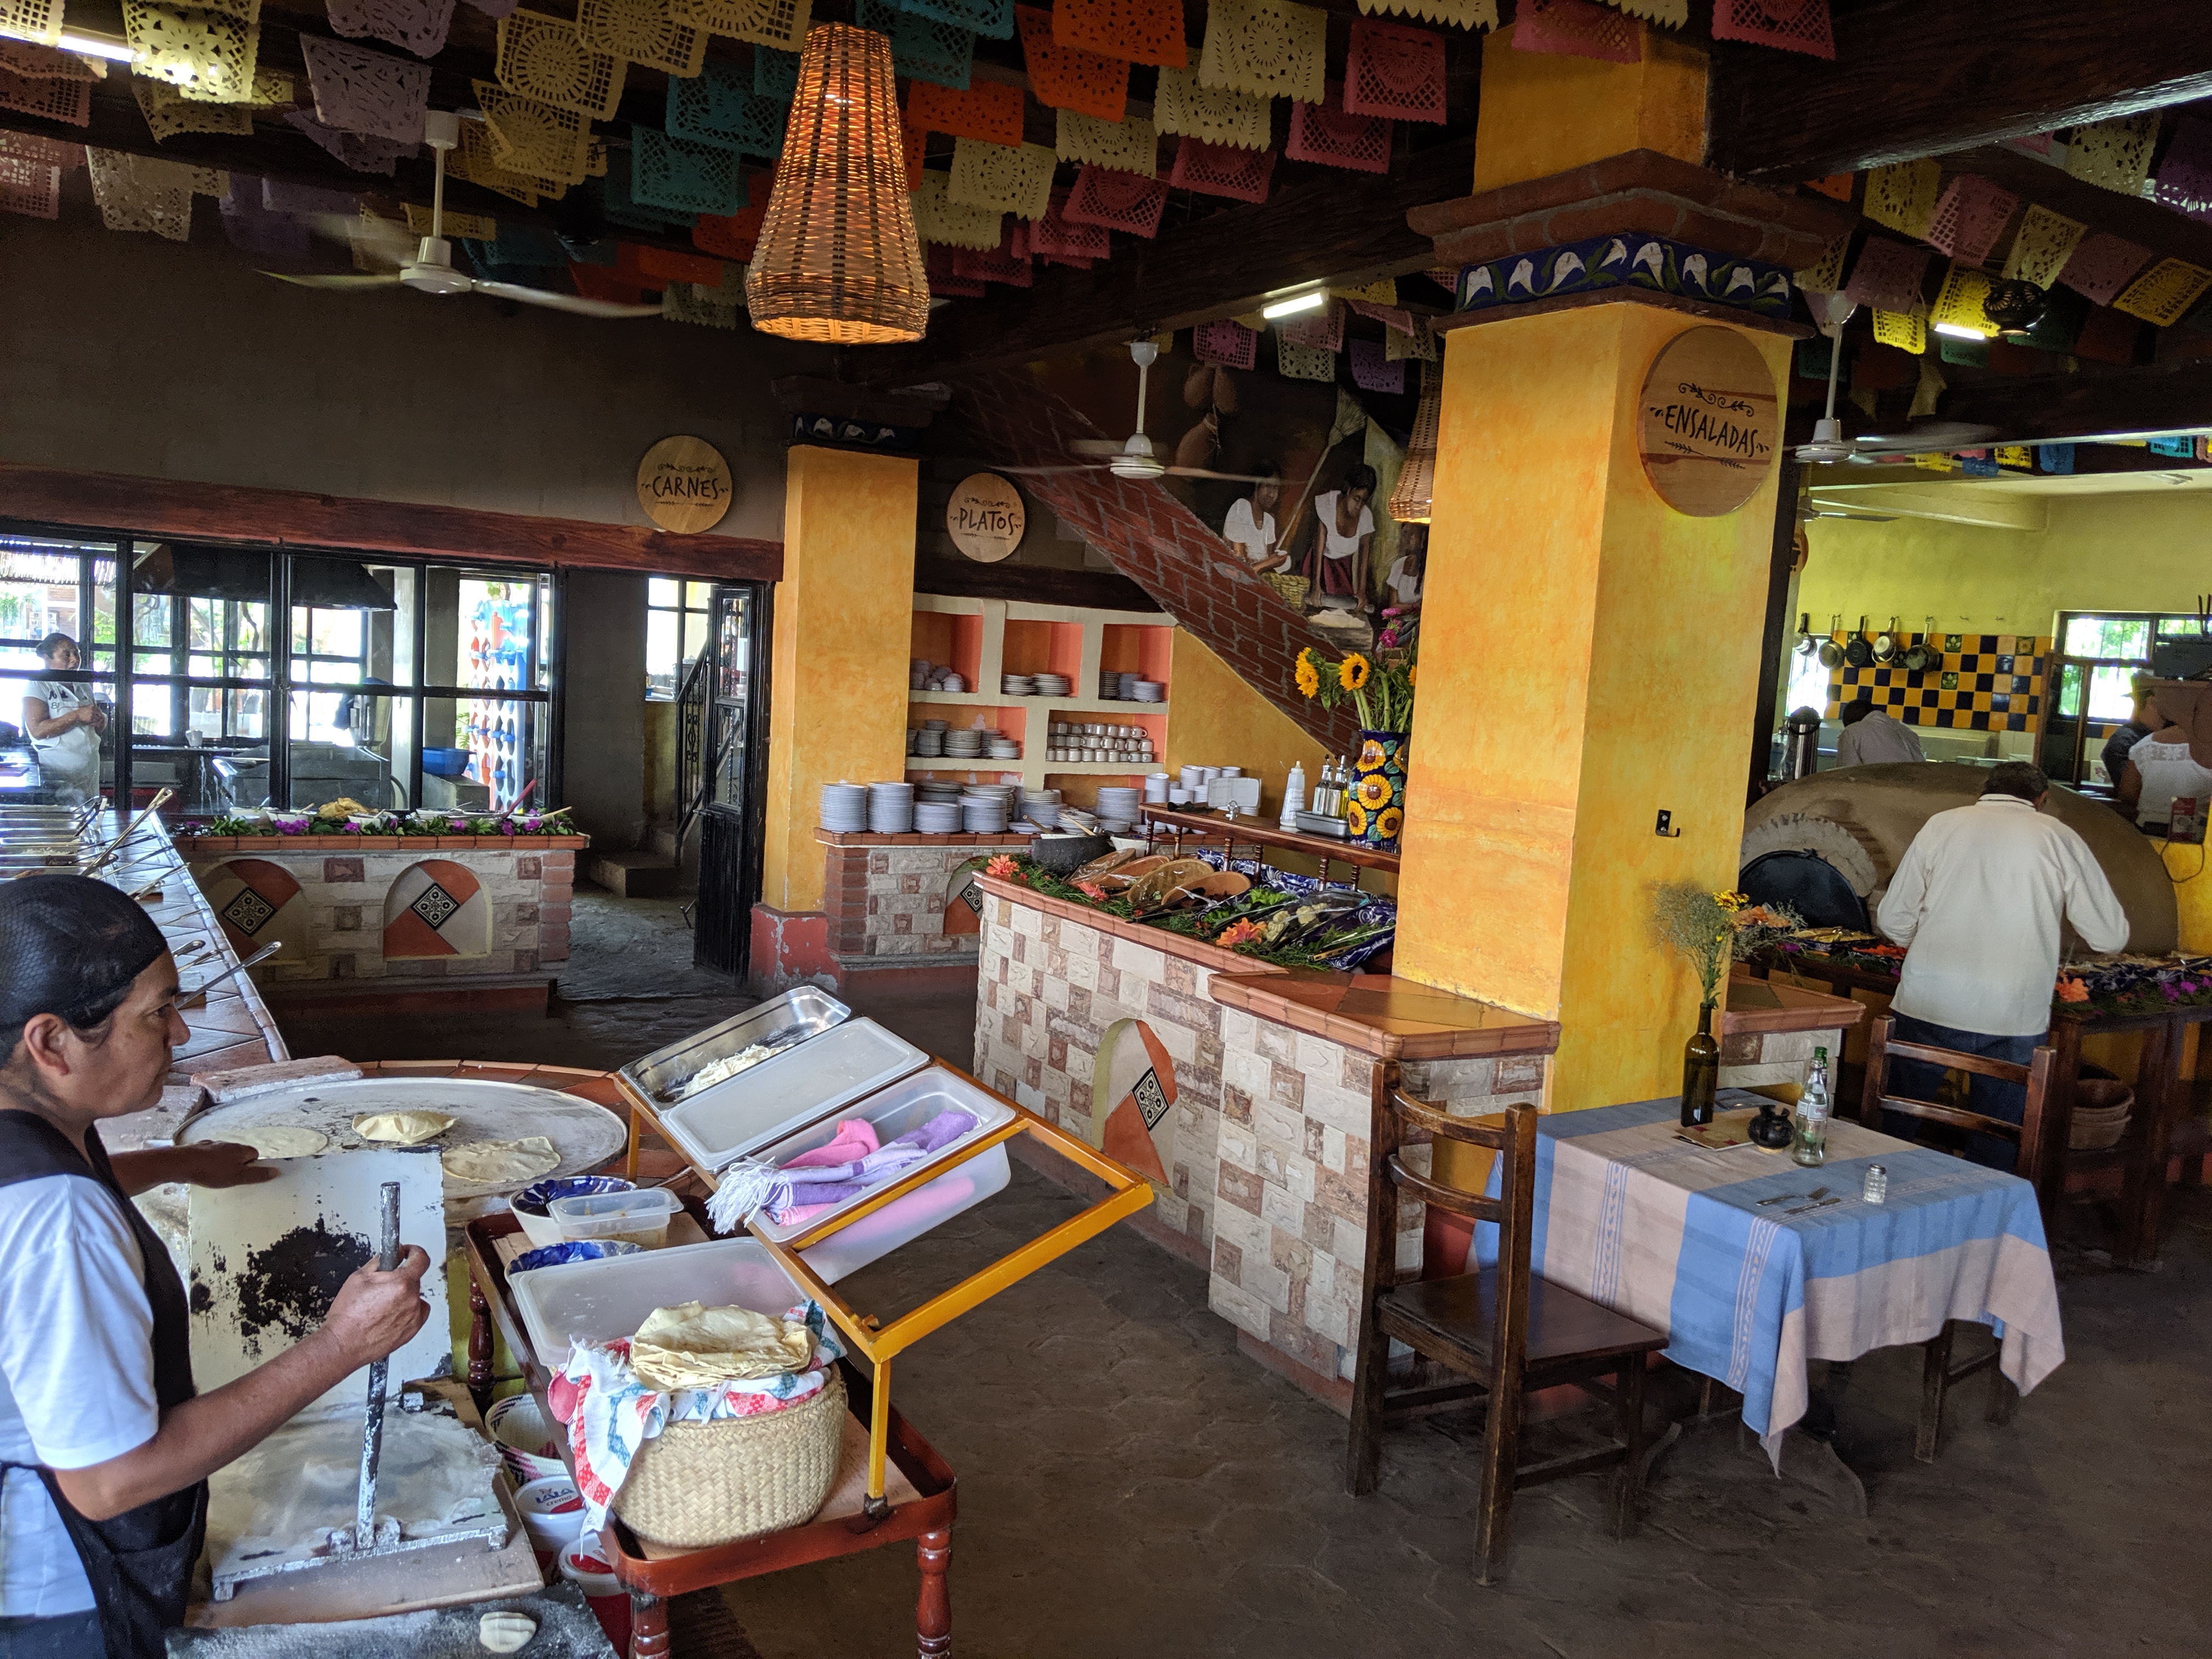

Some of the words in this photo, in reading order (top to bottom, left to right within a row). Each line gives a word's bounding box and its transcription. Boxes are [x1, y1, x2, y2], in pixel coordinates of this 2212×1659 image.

[1664, 405, 1758, 458] ENSALADAS
[652, 476, 718, 500] CARNES
[959, 507, 1014, 535] PLATOS
[546, 1495, 572, 1506] crema
